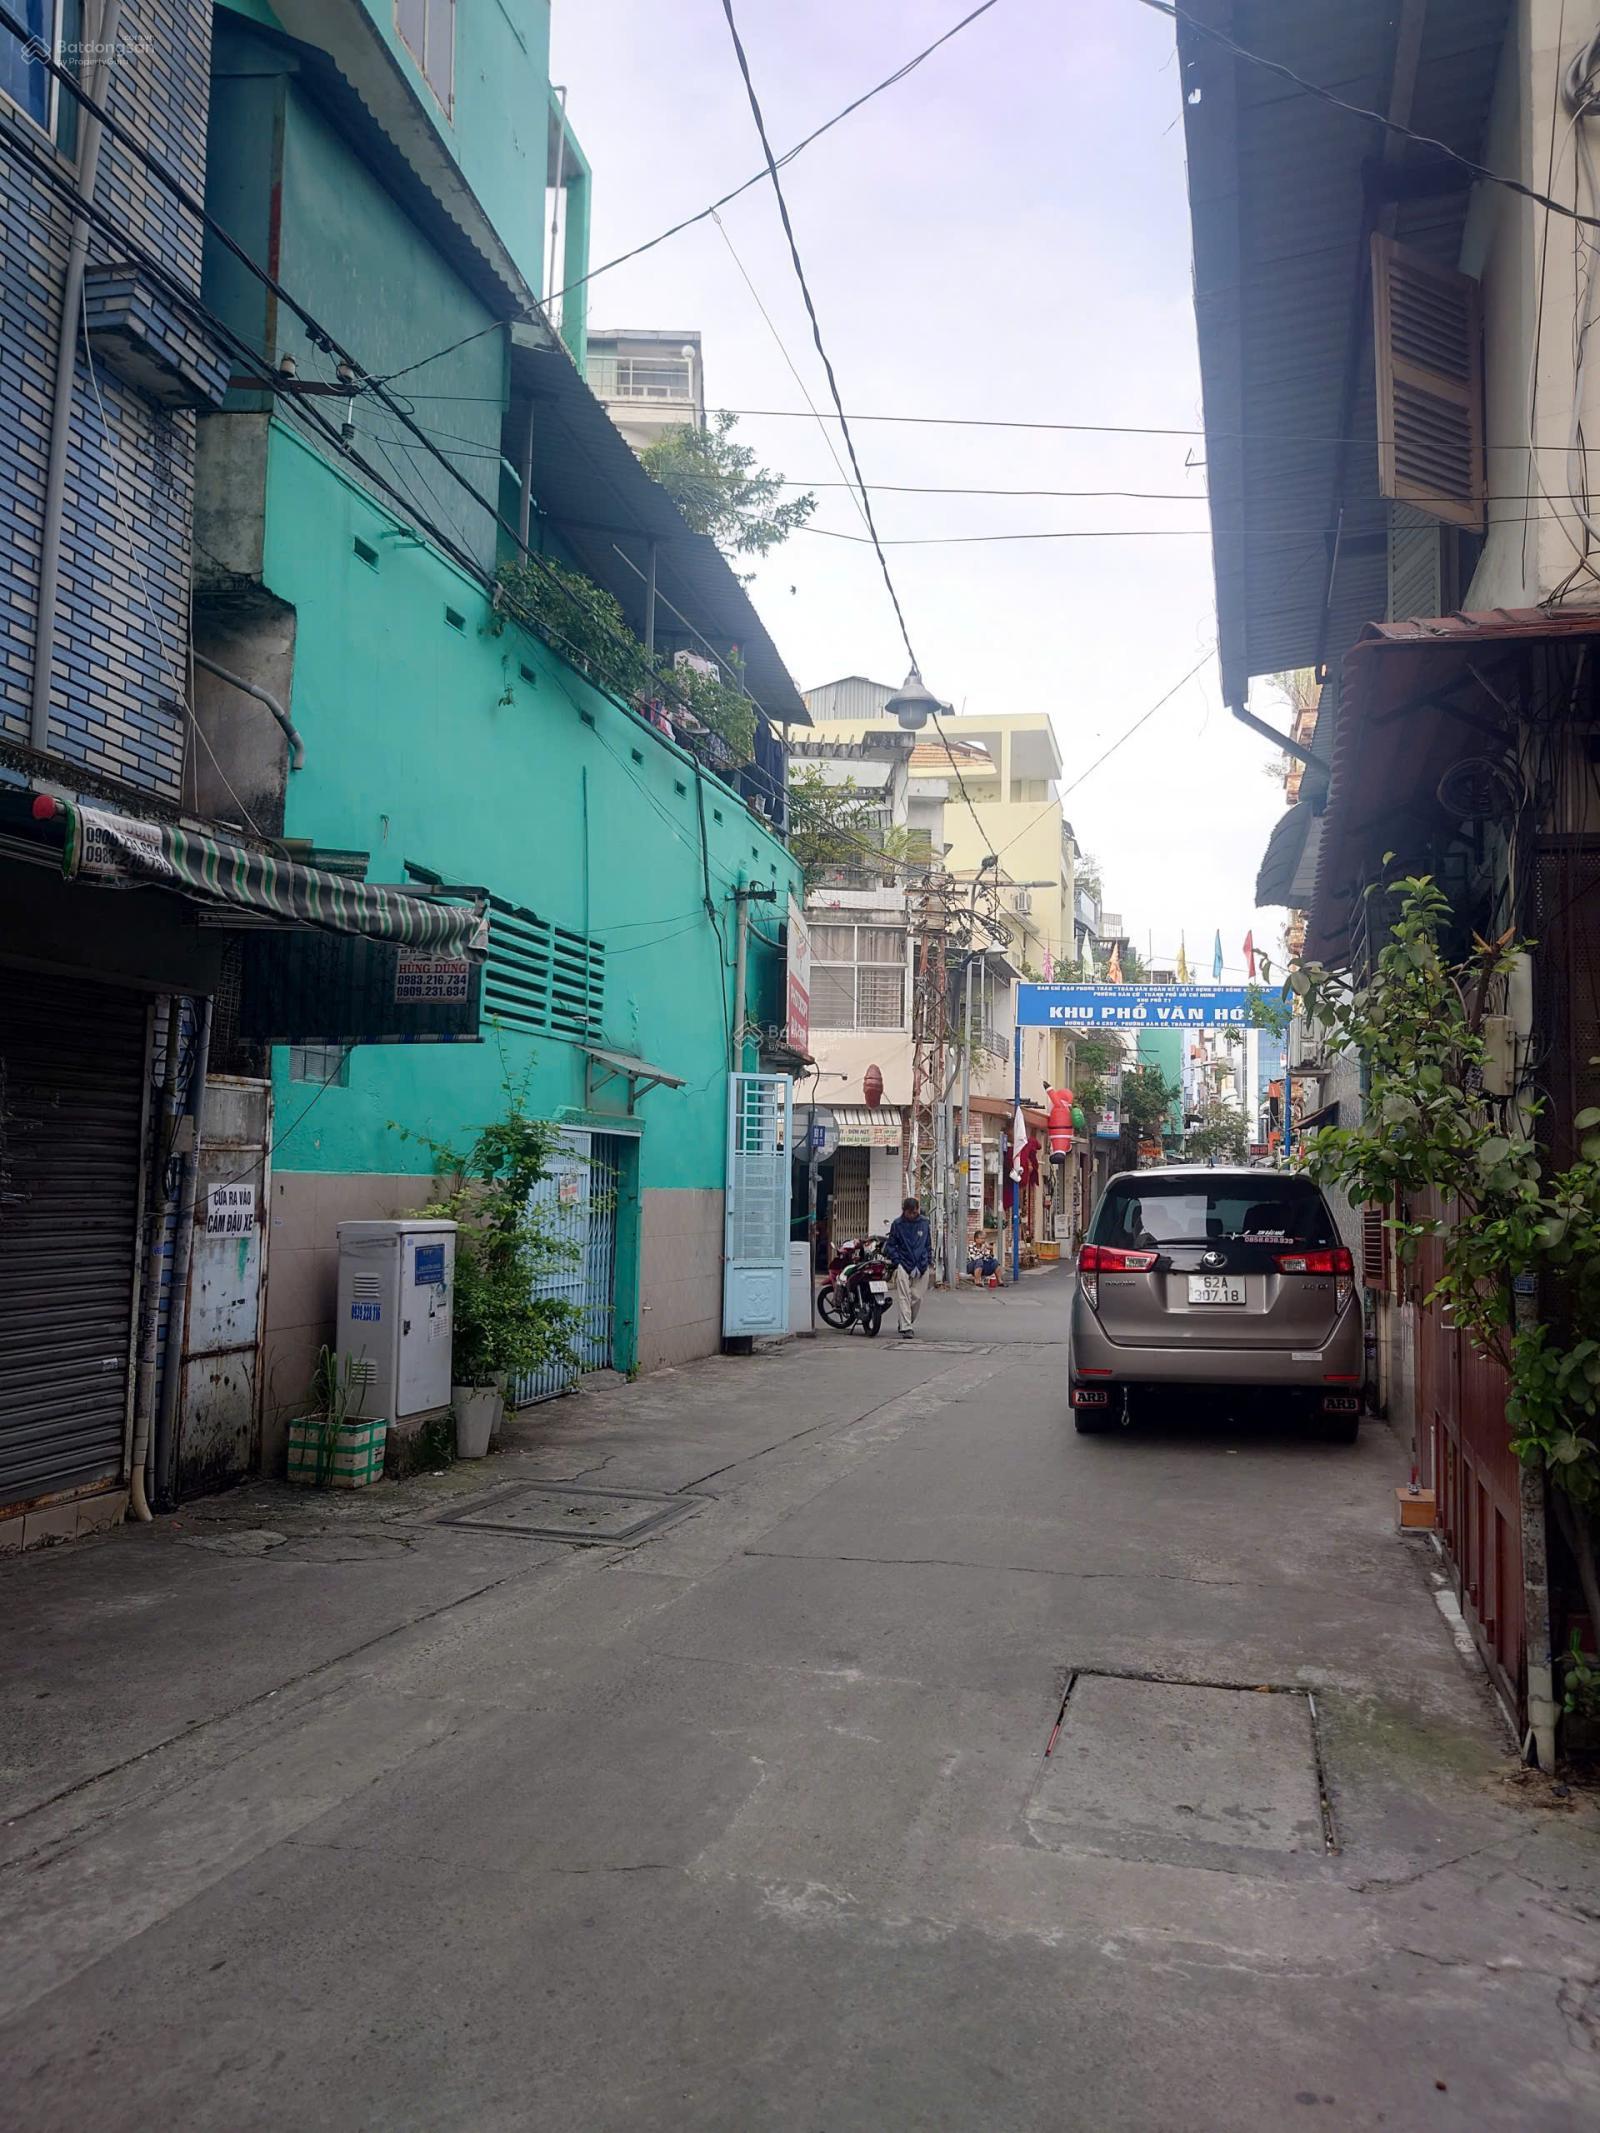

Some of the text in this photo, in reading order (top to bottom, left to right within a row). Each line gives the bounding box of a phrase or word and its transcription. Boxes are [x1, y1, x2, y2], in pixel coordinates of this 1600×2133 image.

[1049, 1006, 1094, 1018] KHU
[1101, 1003, 1147, 1019] PHỐ
[1157, 1005, 1204, 1020] VĂN
[228, 1191, 238, 1206] RA
[238, 1187, 251, 1206] VÀO
[207, 1207, 254, 1236] CẤM ĐẬU XE
[1203, 1276, 1228, 1289] 62A
[1193, 1289, 1239, 1302] 307.18
[1077, 1392, 1105, 1402] ARB
[1326, 1398, 1356, 1409] ARB
